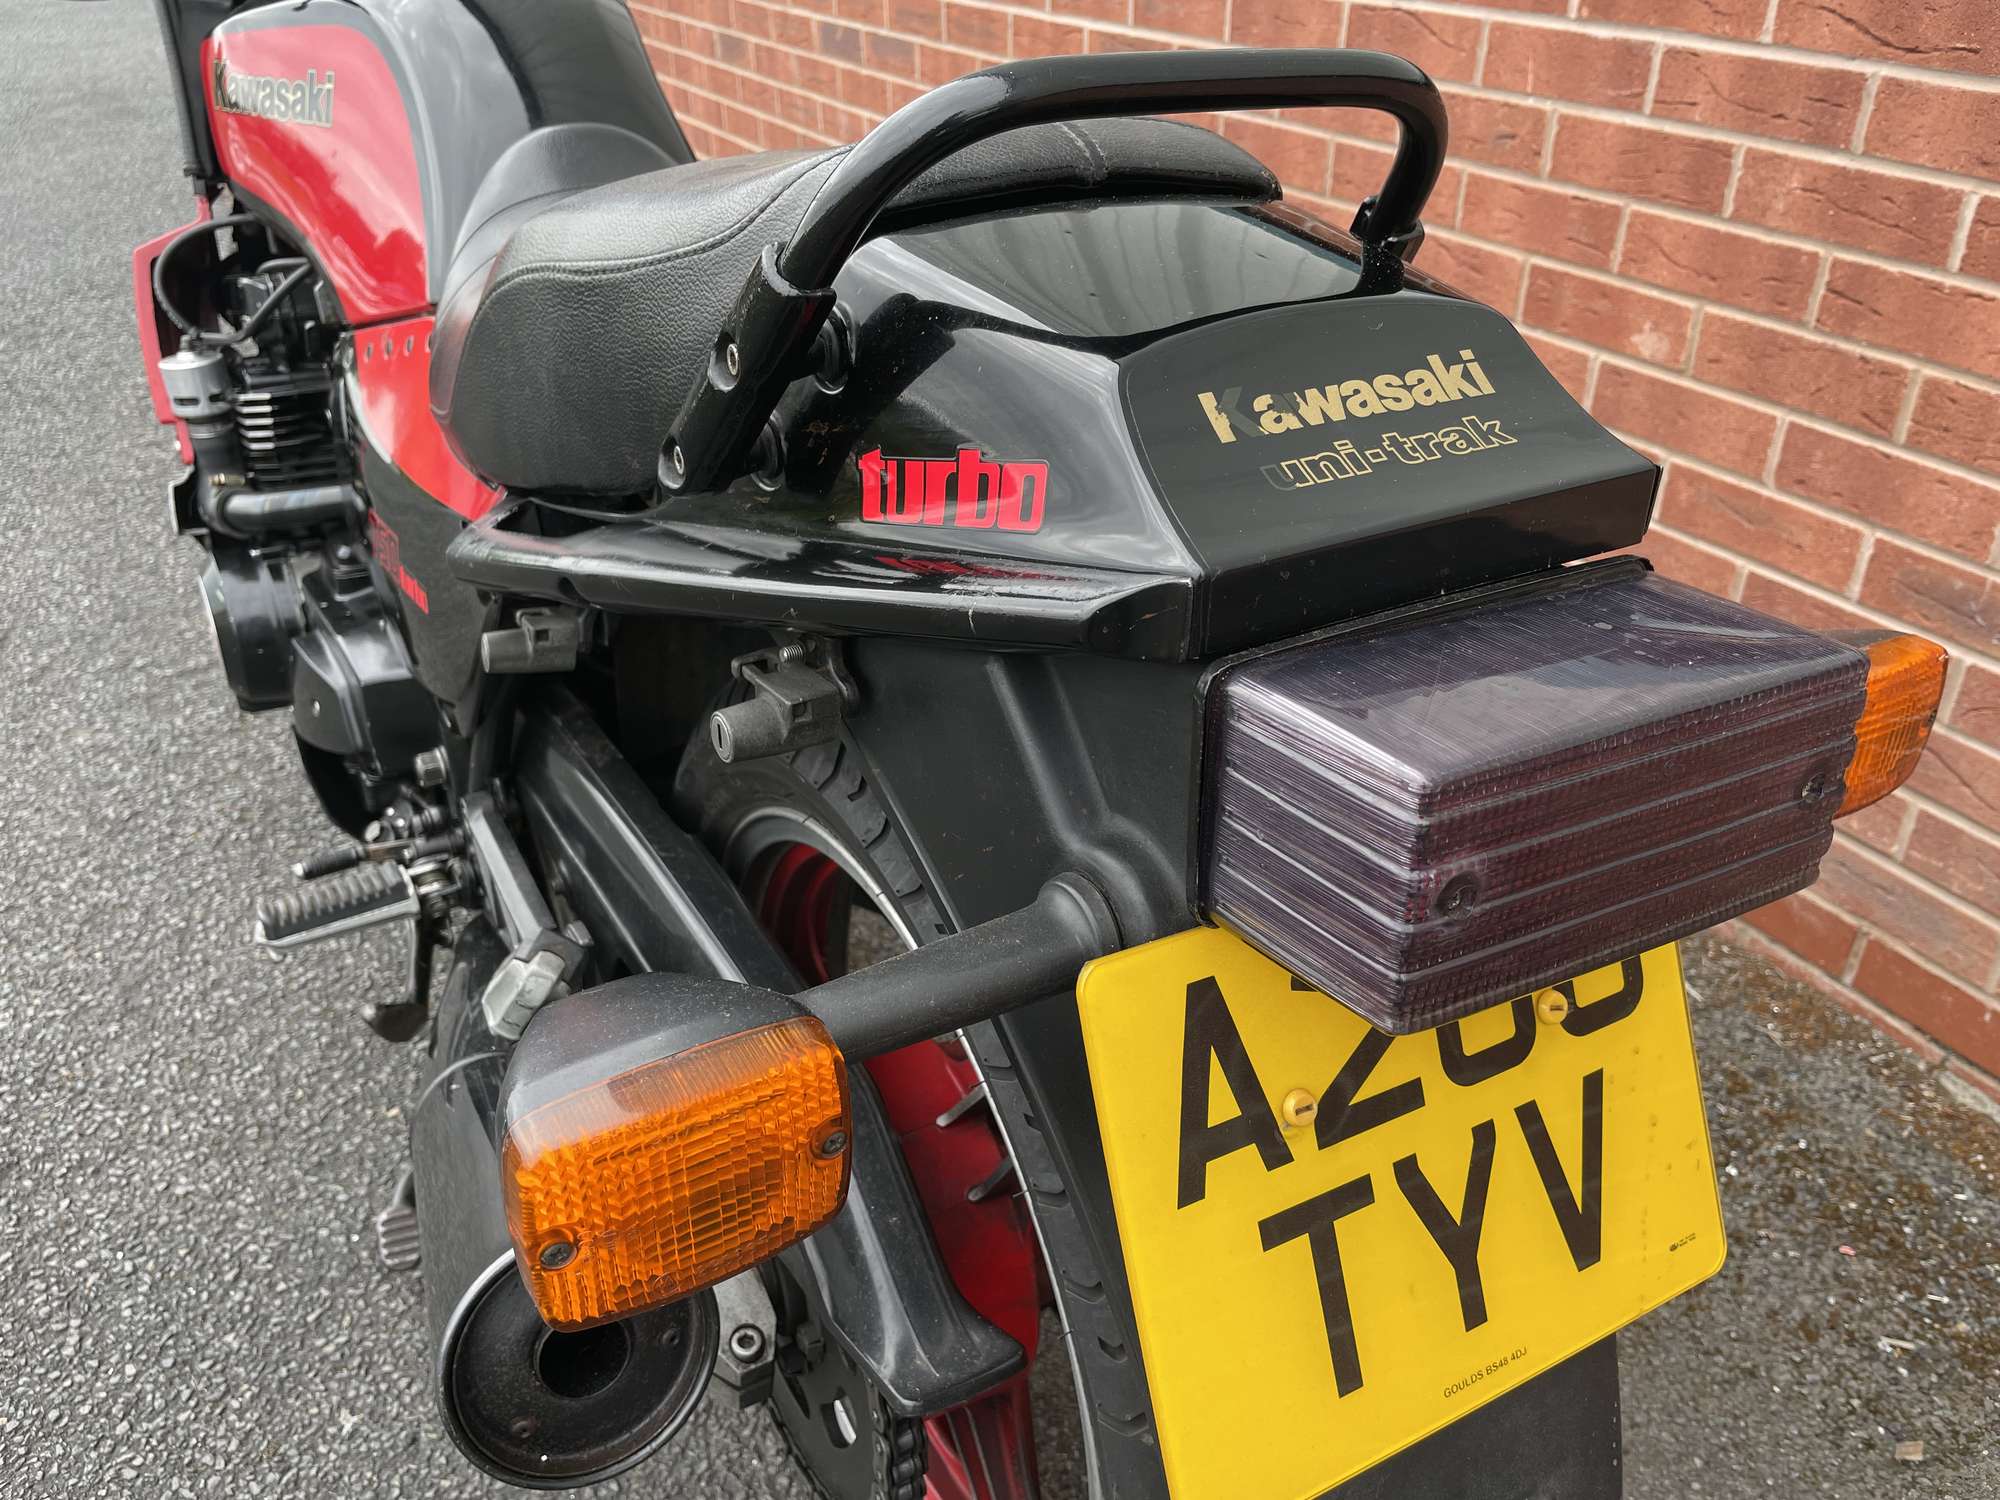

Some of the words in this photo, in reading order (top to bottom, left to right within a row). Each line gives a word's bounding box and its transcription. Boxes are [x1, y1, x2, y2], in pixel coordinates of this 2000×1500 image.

[213, 58, 335, 128] Kawasaki
[1197, 348, 1496, 444] Kawasaki
[858, 446, 1049, 534] turbo
[1260, 416, 1518, 490] uni-trak
[1257, 1067, 1604, 1398] TYV
[1443, 1370, 1484, 1398] GOULDS
[1485, 1356, 1509, 1376] BS48
[1510, 1346, 1528, 1361] 4DJ
